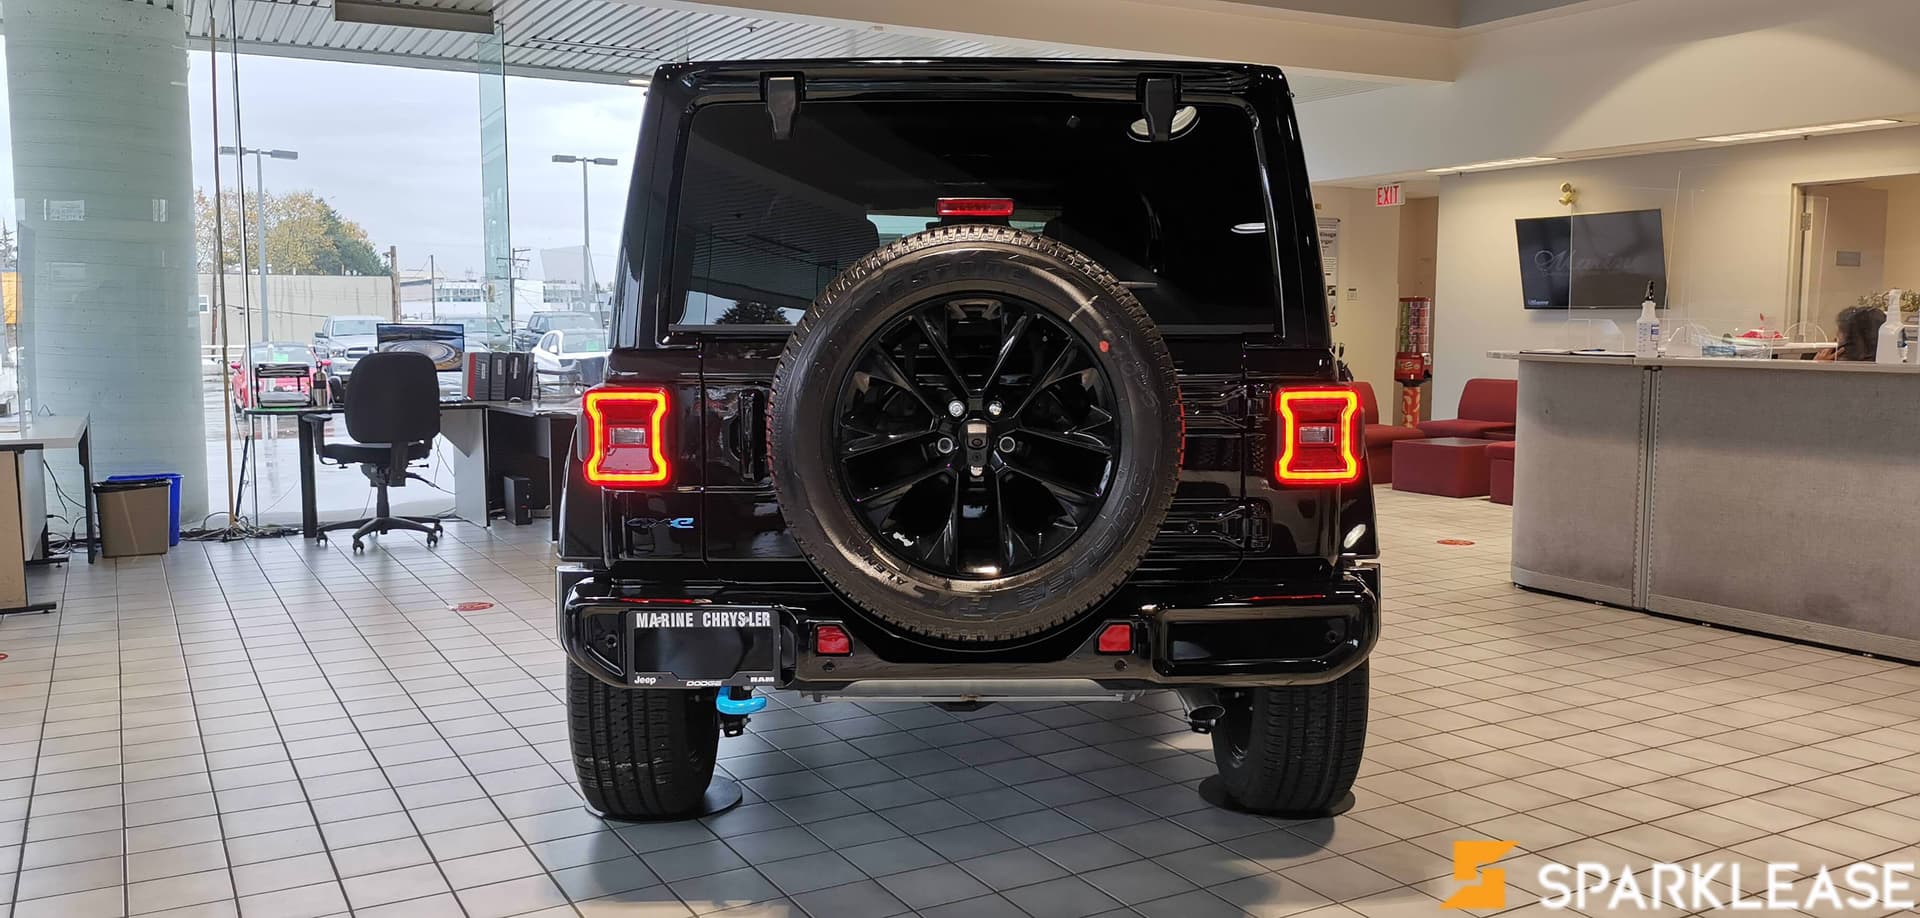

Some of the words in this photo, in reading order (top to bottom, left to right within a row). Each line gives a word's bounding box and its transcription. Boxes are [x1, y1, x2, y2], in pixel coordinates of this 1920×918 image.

[1377, 185, 1399, 205] EXIT
[636, 612, 693, 628] MARINE
[702, 611, 771, 628] CHRYSLER
[634, 675, 657, 686] Jeep
